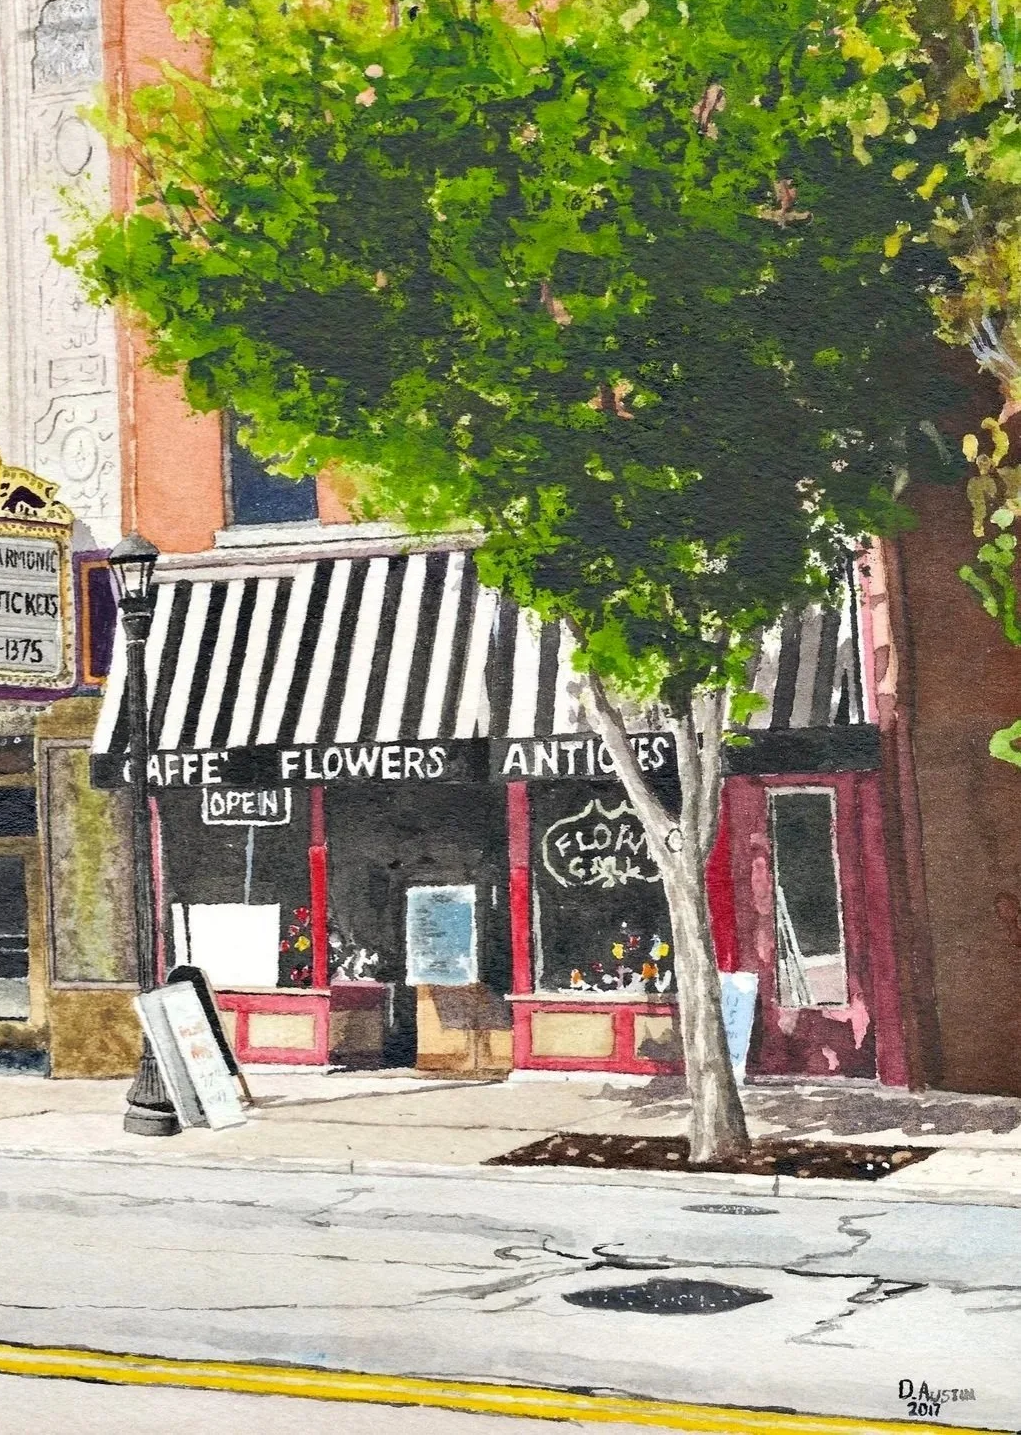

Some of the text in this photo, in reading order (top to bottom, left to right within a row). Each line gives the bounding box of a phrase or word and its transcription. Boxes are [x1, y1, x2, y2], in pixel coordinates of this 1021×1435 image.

[281, 745, 447, 780] FLOWERS
[499, 736, 670, 776] ANTIQES
[210, 790, 278, 817] OPEN
[898, 1379, 917, 1400] D.
[907, 1401, 941, 1417] 2017
